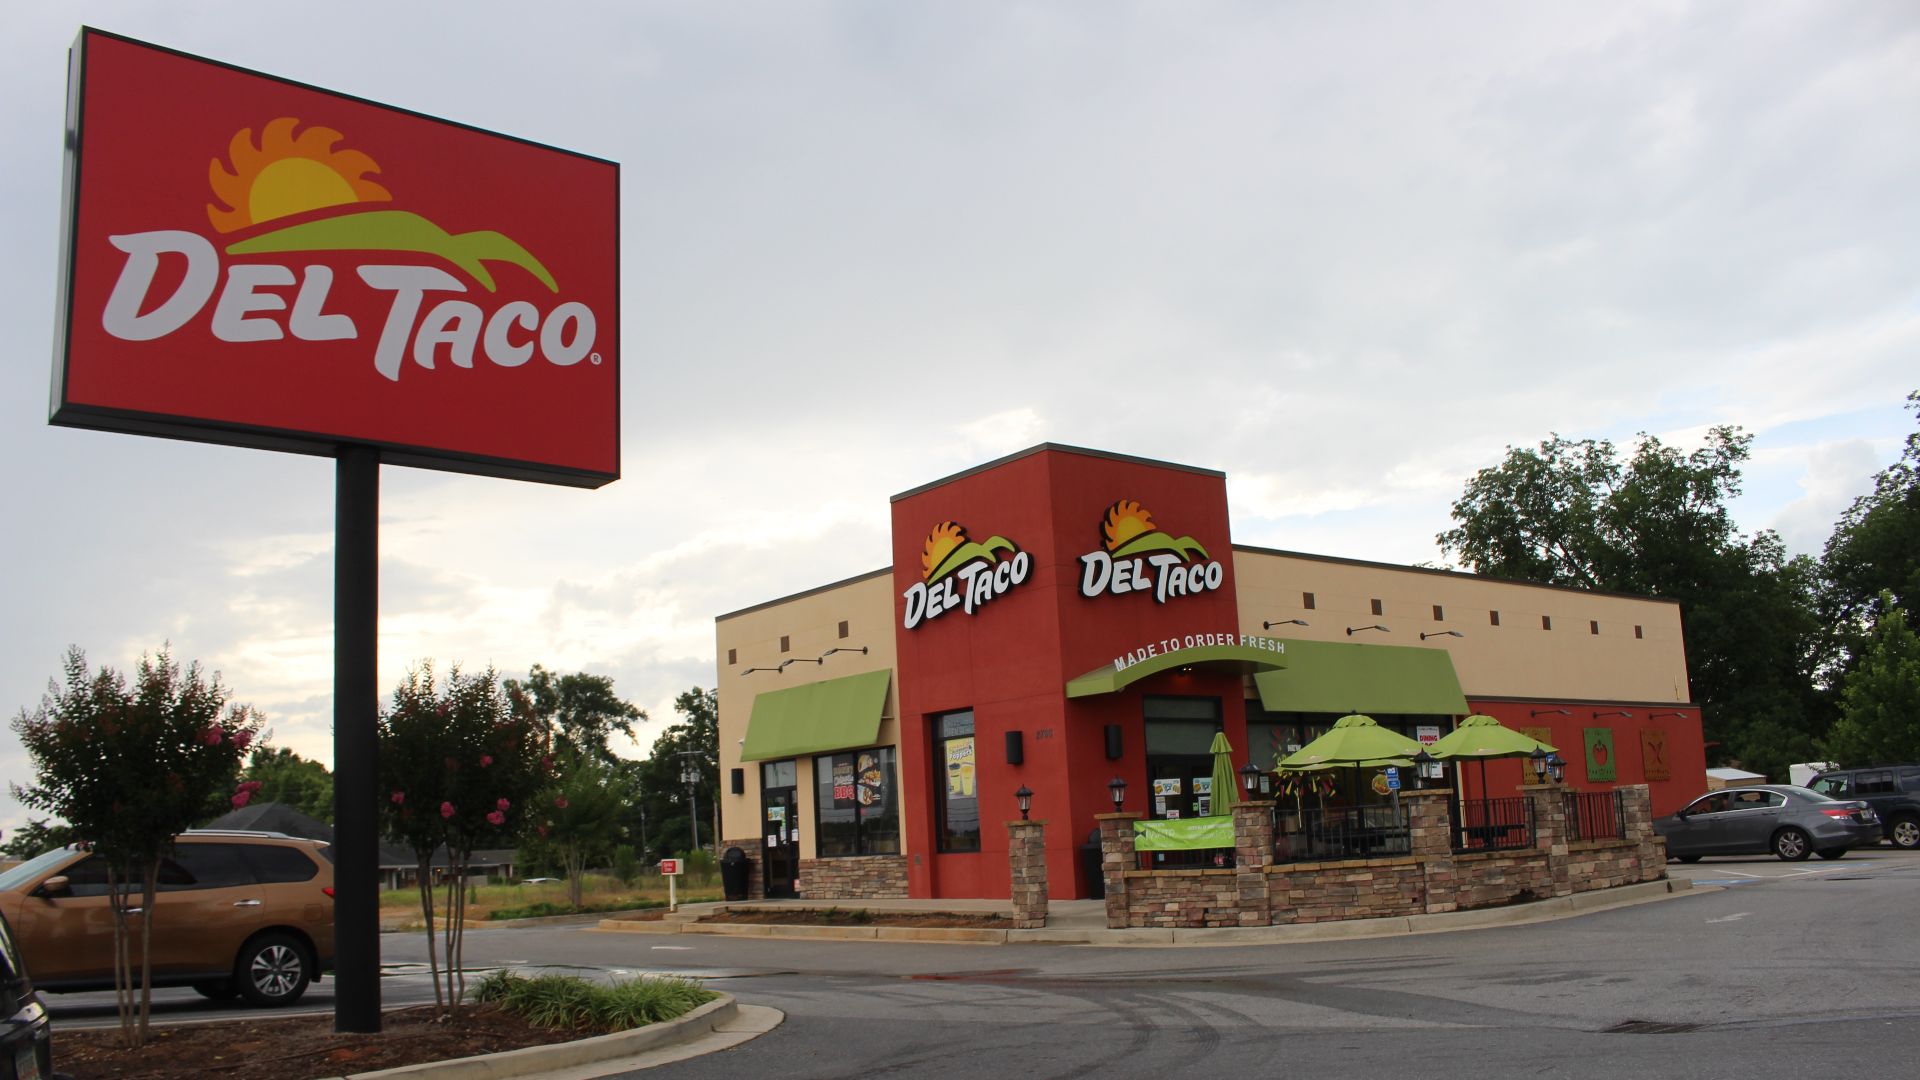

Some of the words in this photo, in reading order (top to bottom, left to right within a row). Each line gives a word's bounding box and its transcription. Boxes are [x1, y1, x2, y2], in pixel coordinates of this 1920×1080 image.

[102, 230, 358, 342] DEL
[356, 265, 597, 381] TACO
[903, 576, 961, 630] DEL
[957, 551, 1029, 615] TACO
[1081, 550, 1151, 597] DEL
[1149, 553, 1223, 604] TACO
[1114, 643, 1157, 672] MADE
[1160, 638, 1180, 654] TO
[1184, 633, 1235, 648] ORDER
[1240, 634, 1285, 654] FRESH
[833, 786, 855, 800] BBQ
